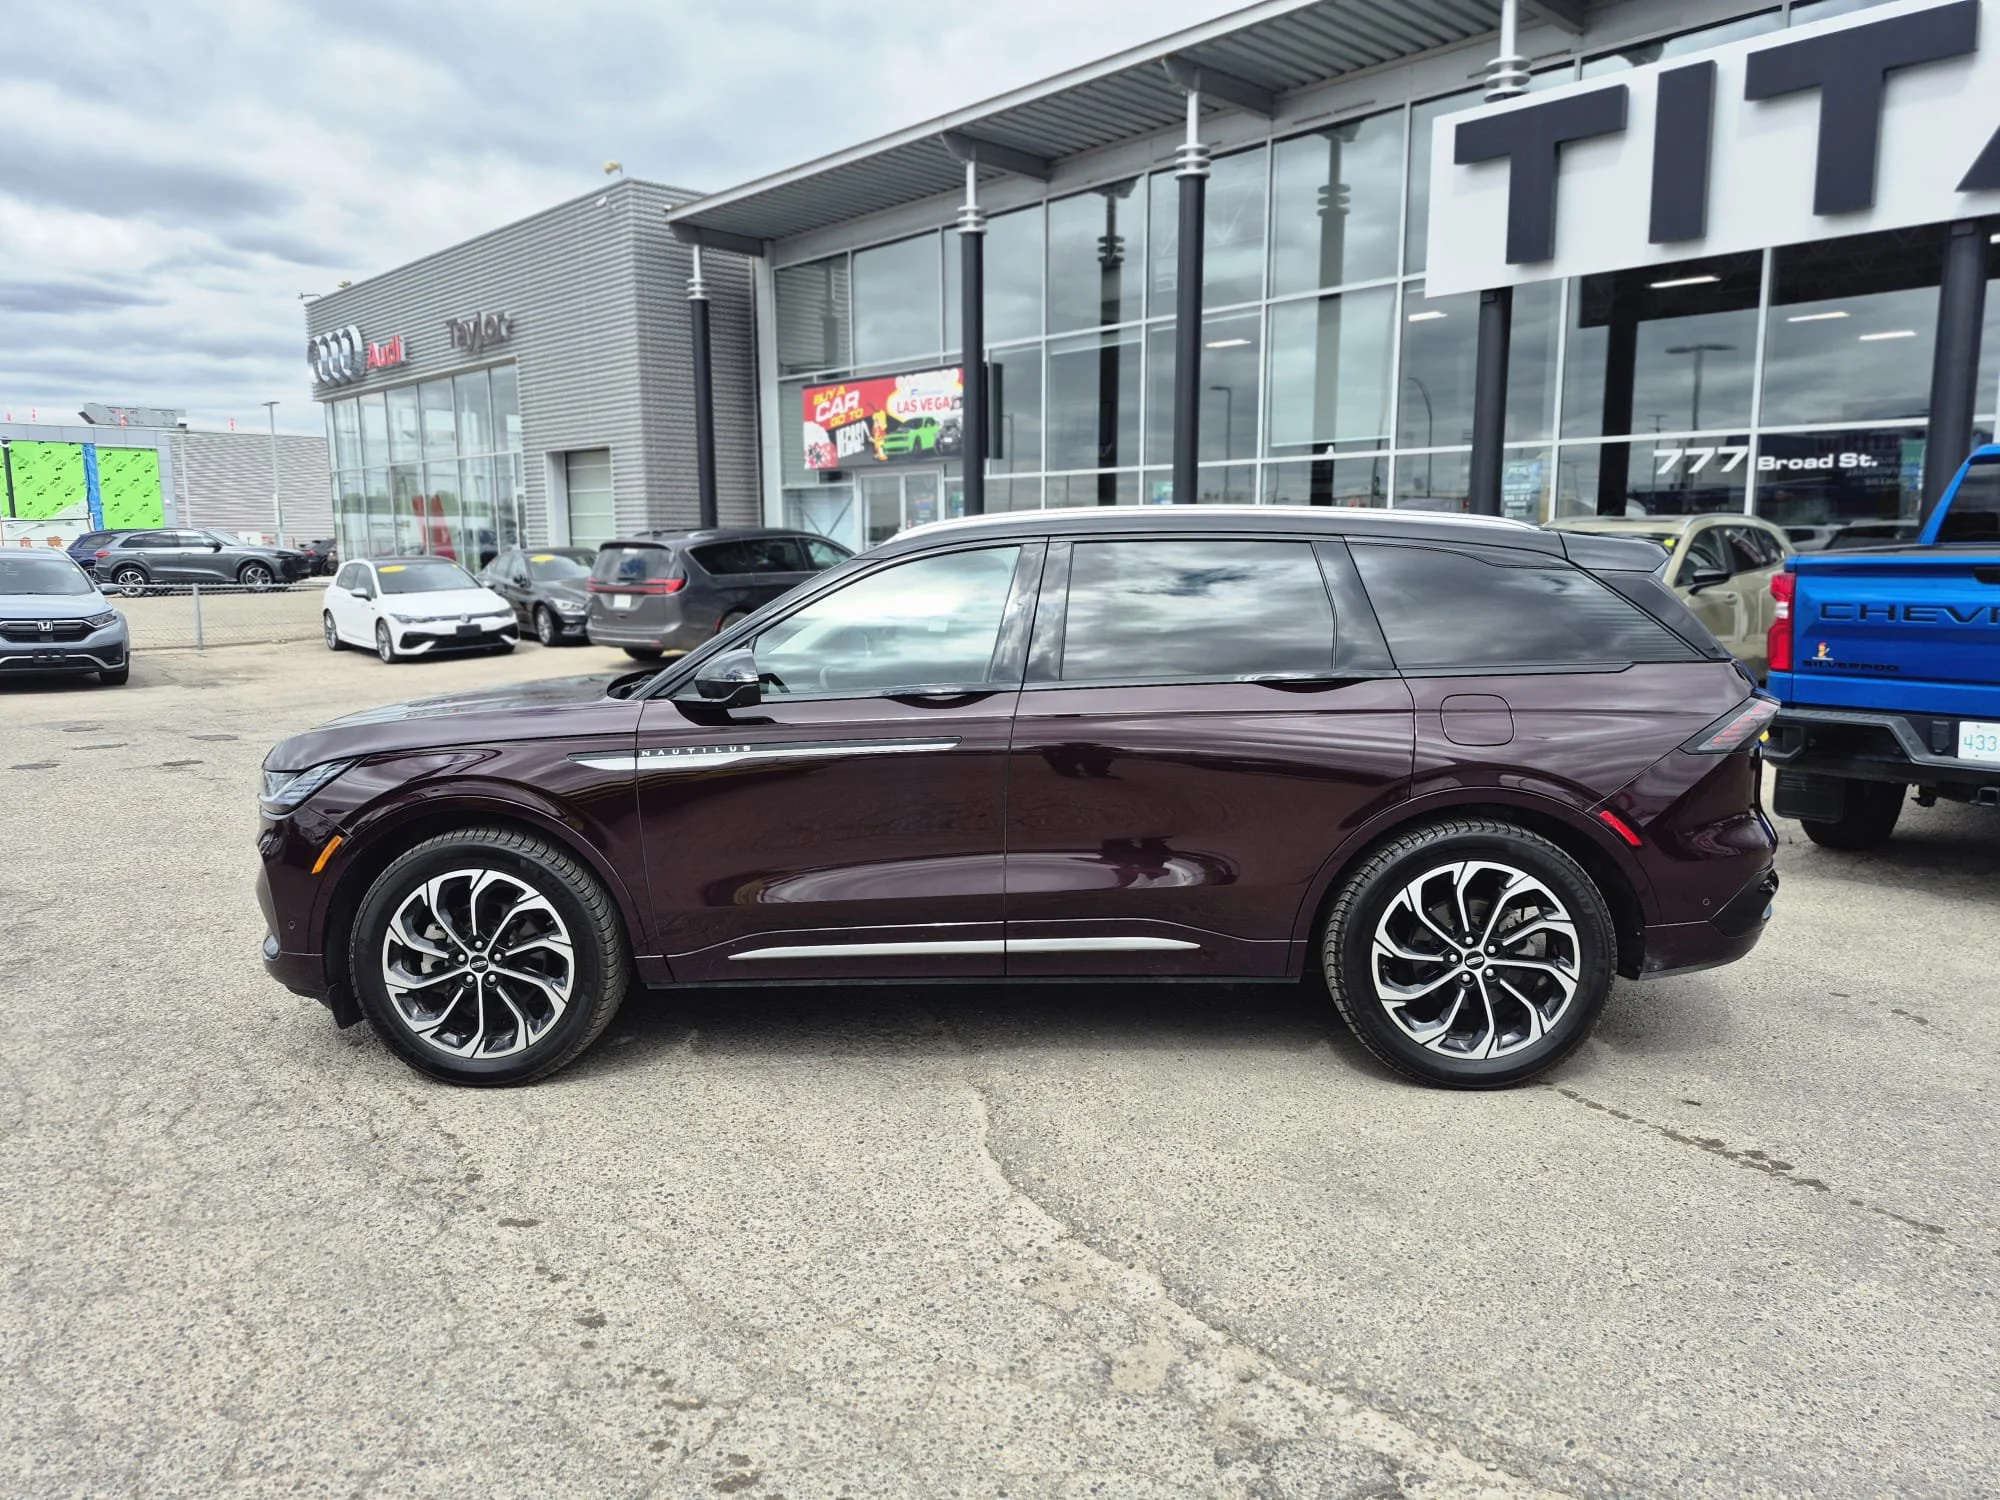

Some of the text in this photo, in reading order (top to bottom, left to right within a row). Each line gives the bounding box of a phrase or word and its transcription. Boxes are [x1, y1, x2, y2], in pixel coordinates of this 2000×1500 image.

[446, 311, 513, 353] Taylor
[367, 335, 405, 369] Audi
[813, 385, 846, 406] BUY A
[815, 390, 860, 422] CAR
[896, 399, 918, 413] LAS
[830, 408, 864, 427] GO TO
[1653, 446, 1748, 475] 777
[1757, 454, 1833, 471] Broad
[1838, 452, 1878, 468] St.
[1802, 659, 1900, 671] SILVERADO
[640, 745, 751, 757] NAUTILUS
[1964, 734, 1997, 752] 433
